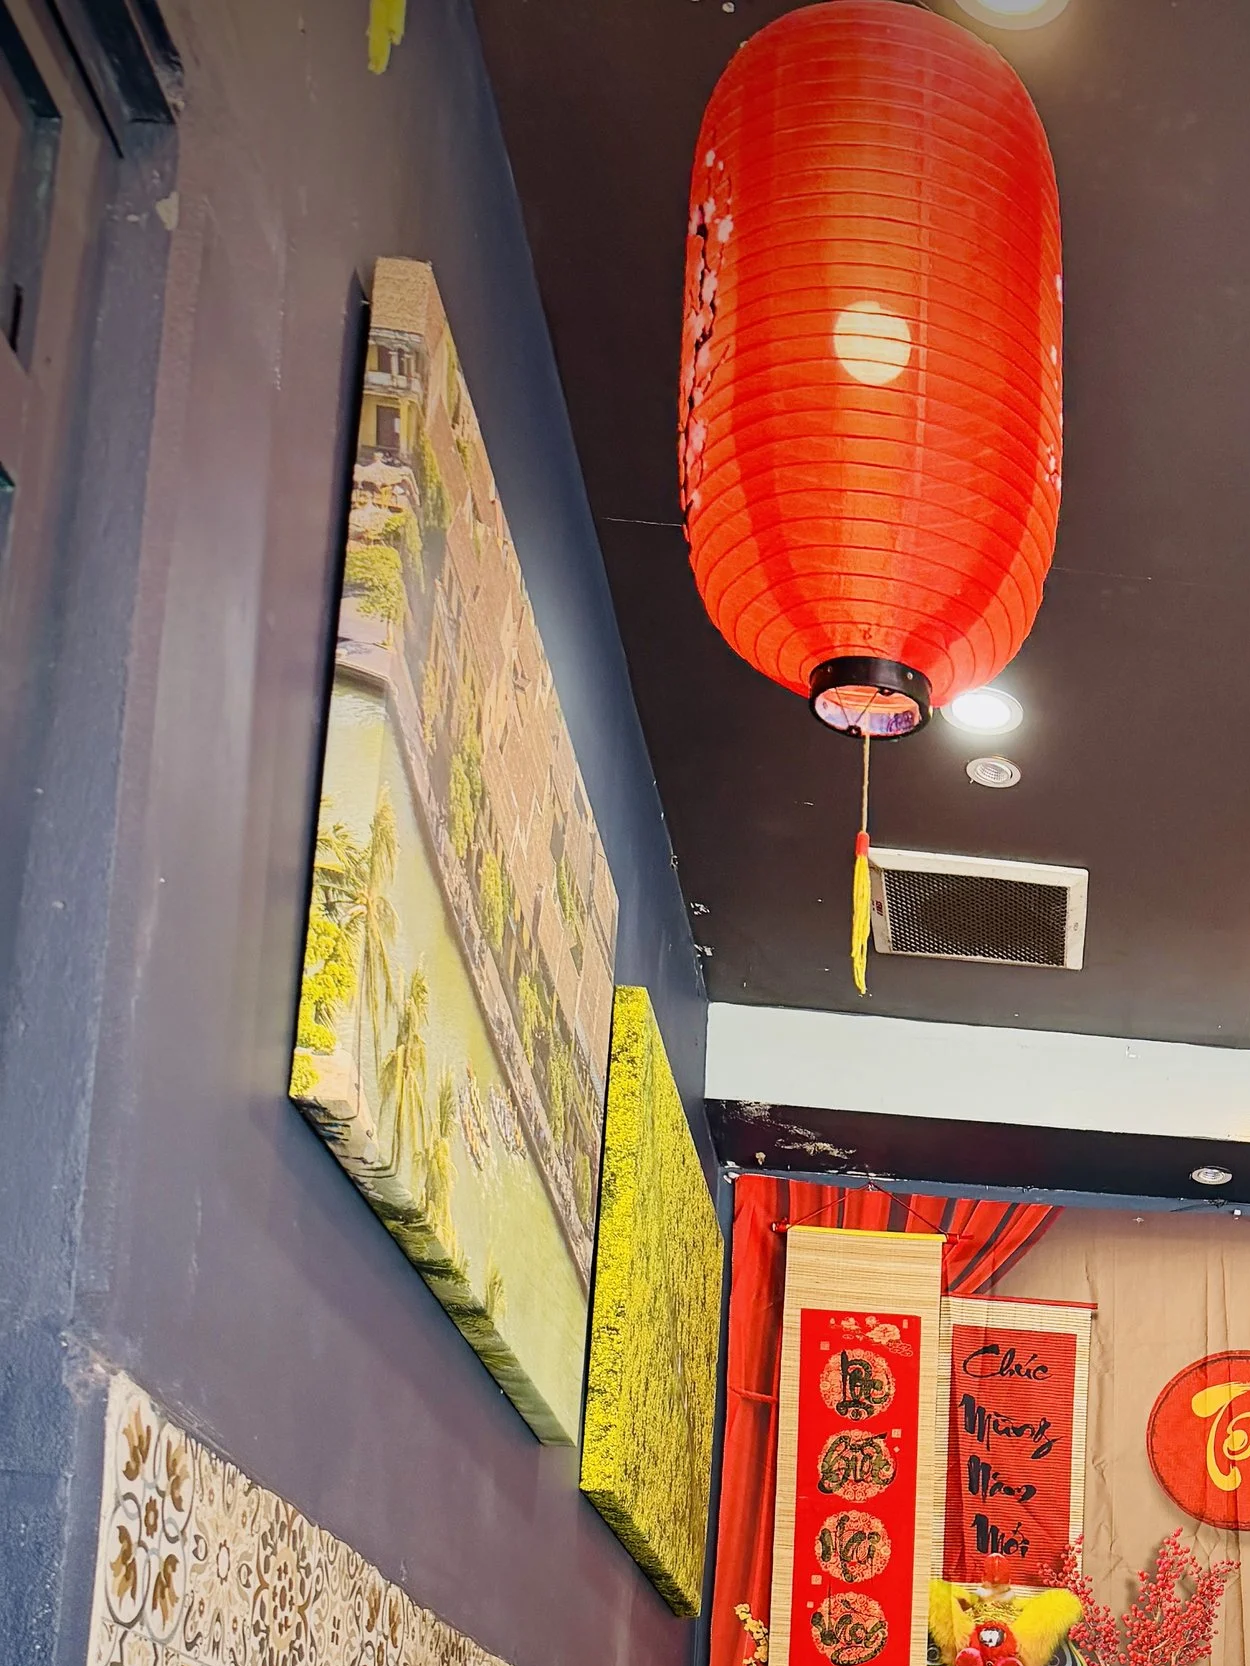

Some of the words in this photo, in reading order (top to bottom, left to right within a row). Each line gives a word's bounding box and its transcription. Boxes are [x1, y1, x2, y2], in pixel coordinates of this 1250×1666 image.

[963, 1344, 1053, 1381] Chúc
[958, 1393, 1063, 1460] Mừng
[968, 1455, 1036, 1503] Năm
[970, 1513, 1030, 1558] Mới
